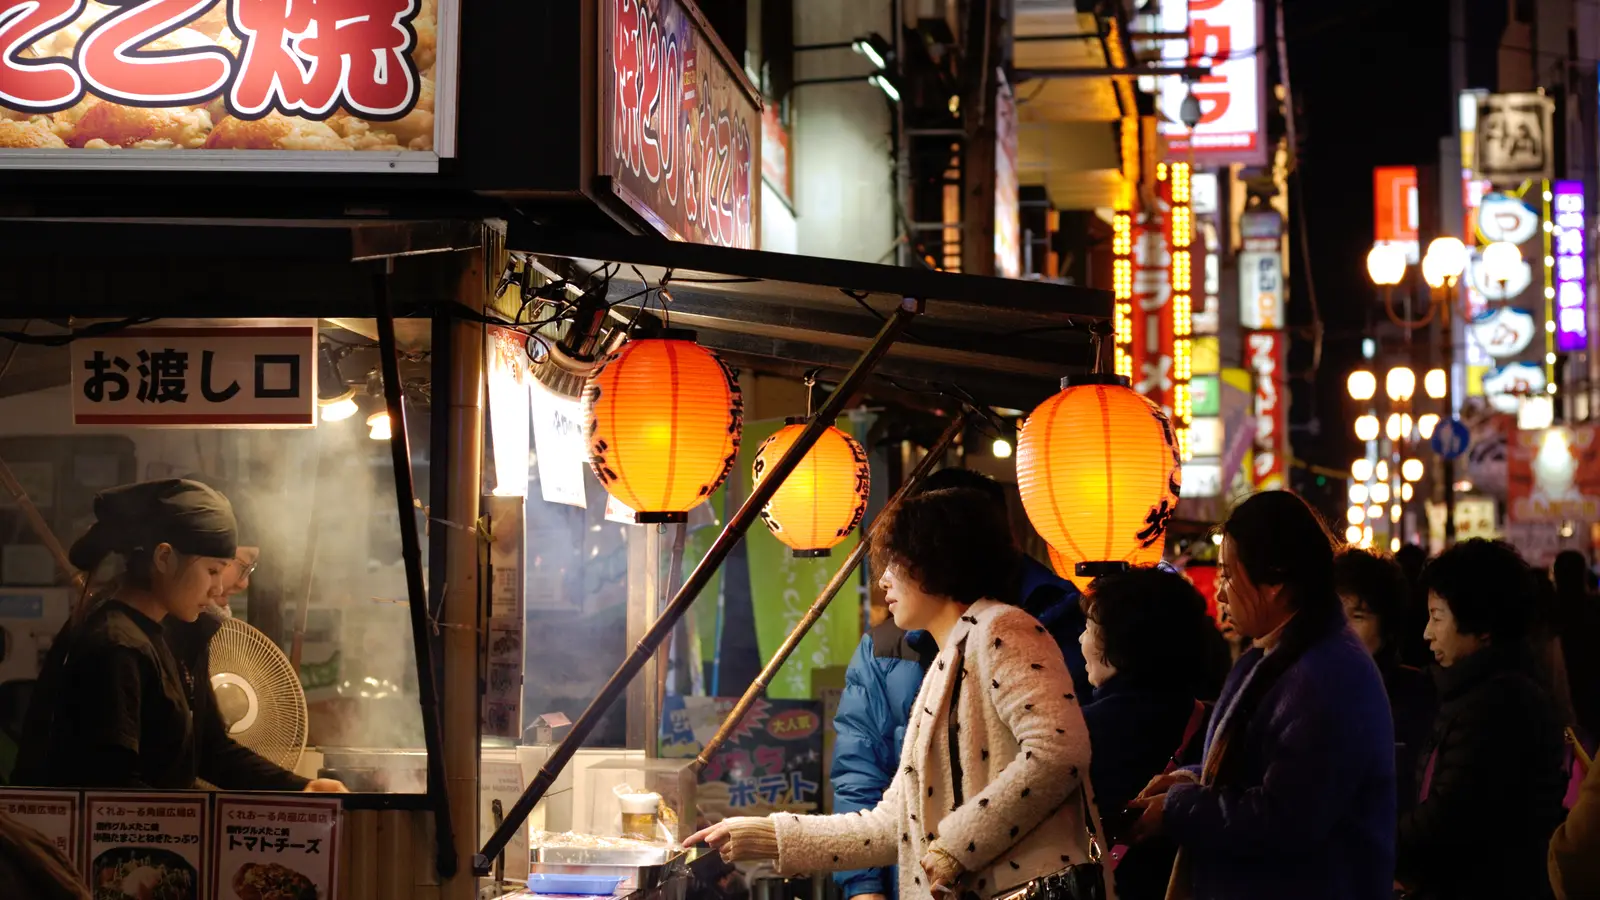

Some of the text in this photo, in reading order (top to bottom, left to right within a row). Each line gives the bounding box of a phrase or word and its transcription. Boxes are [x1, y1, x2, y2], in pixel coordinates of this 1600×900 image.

[83, 348, 300, 404] お渡し口
[728, 771, 819, 807] ポテト
[228, 835, 324, 855] トマトチーズ
